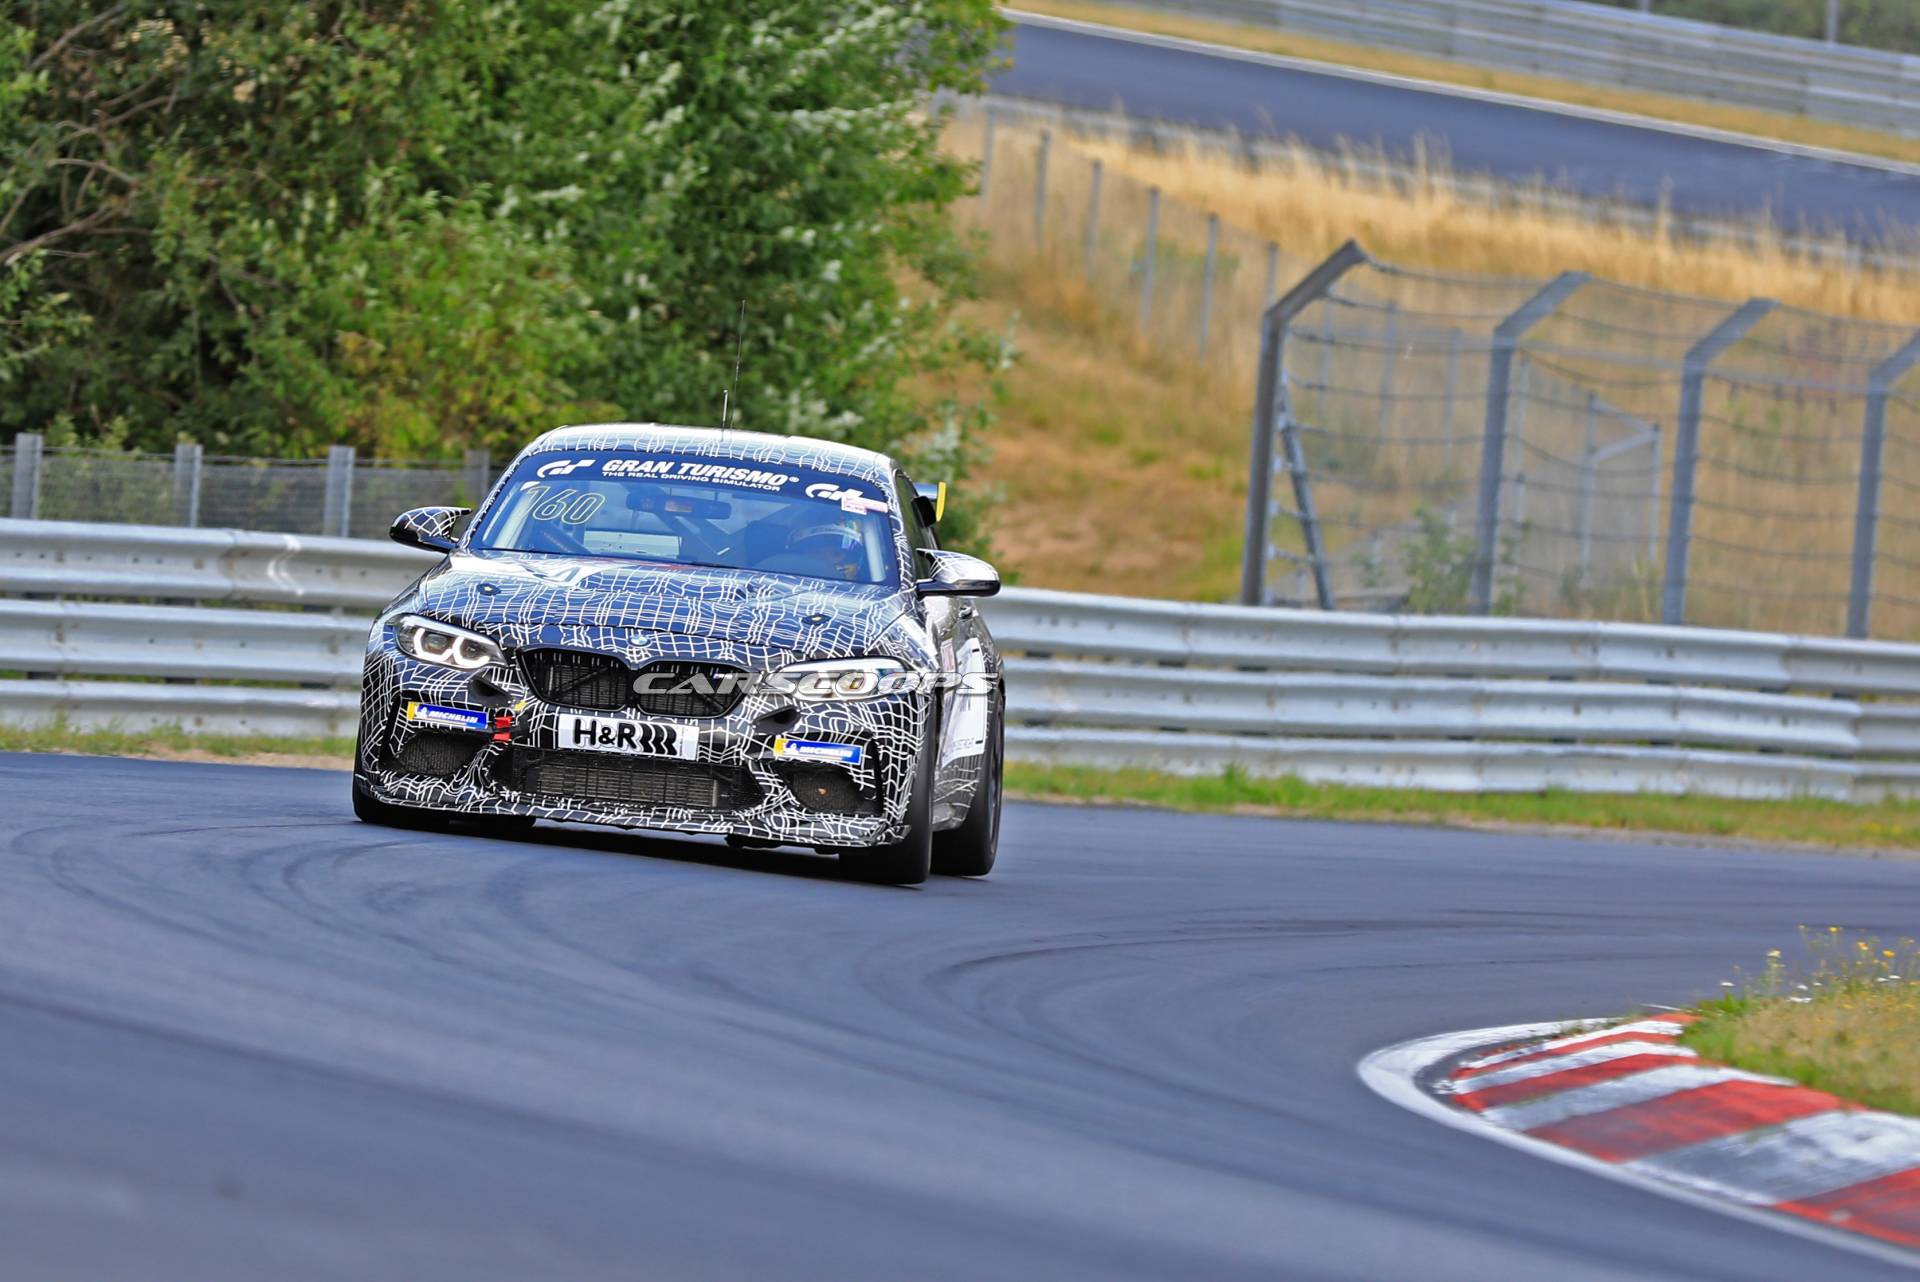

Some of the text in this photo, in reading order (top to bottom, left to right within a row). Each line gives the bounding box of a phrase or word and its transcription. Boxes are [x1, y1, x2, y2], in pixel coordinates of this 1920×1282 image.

[602, 459, 675, 474] GRAN
[660, 473, 709, 482] DRIVING
[711, 477, 781, 492] SIMULATOR
[526, 485, 605, 525] 160
[428, 710, 479, 723] MICHELIN
